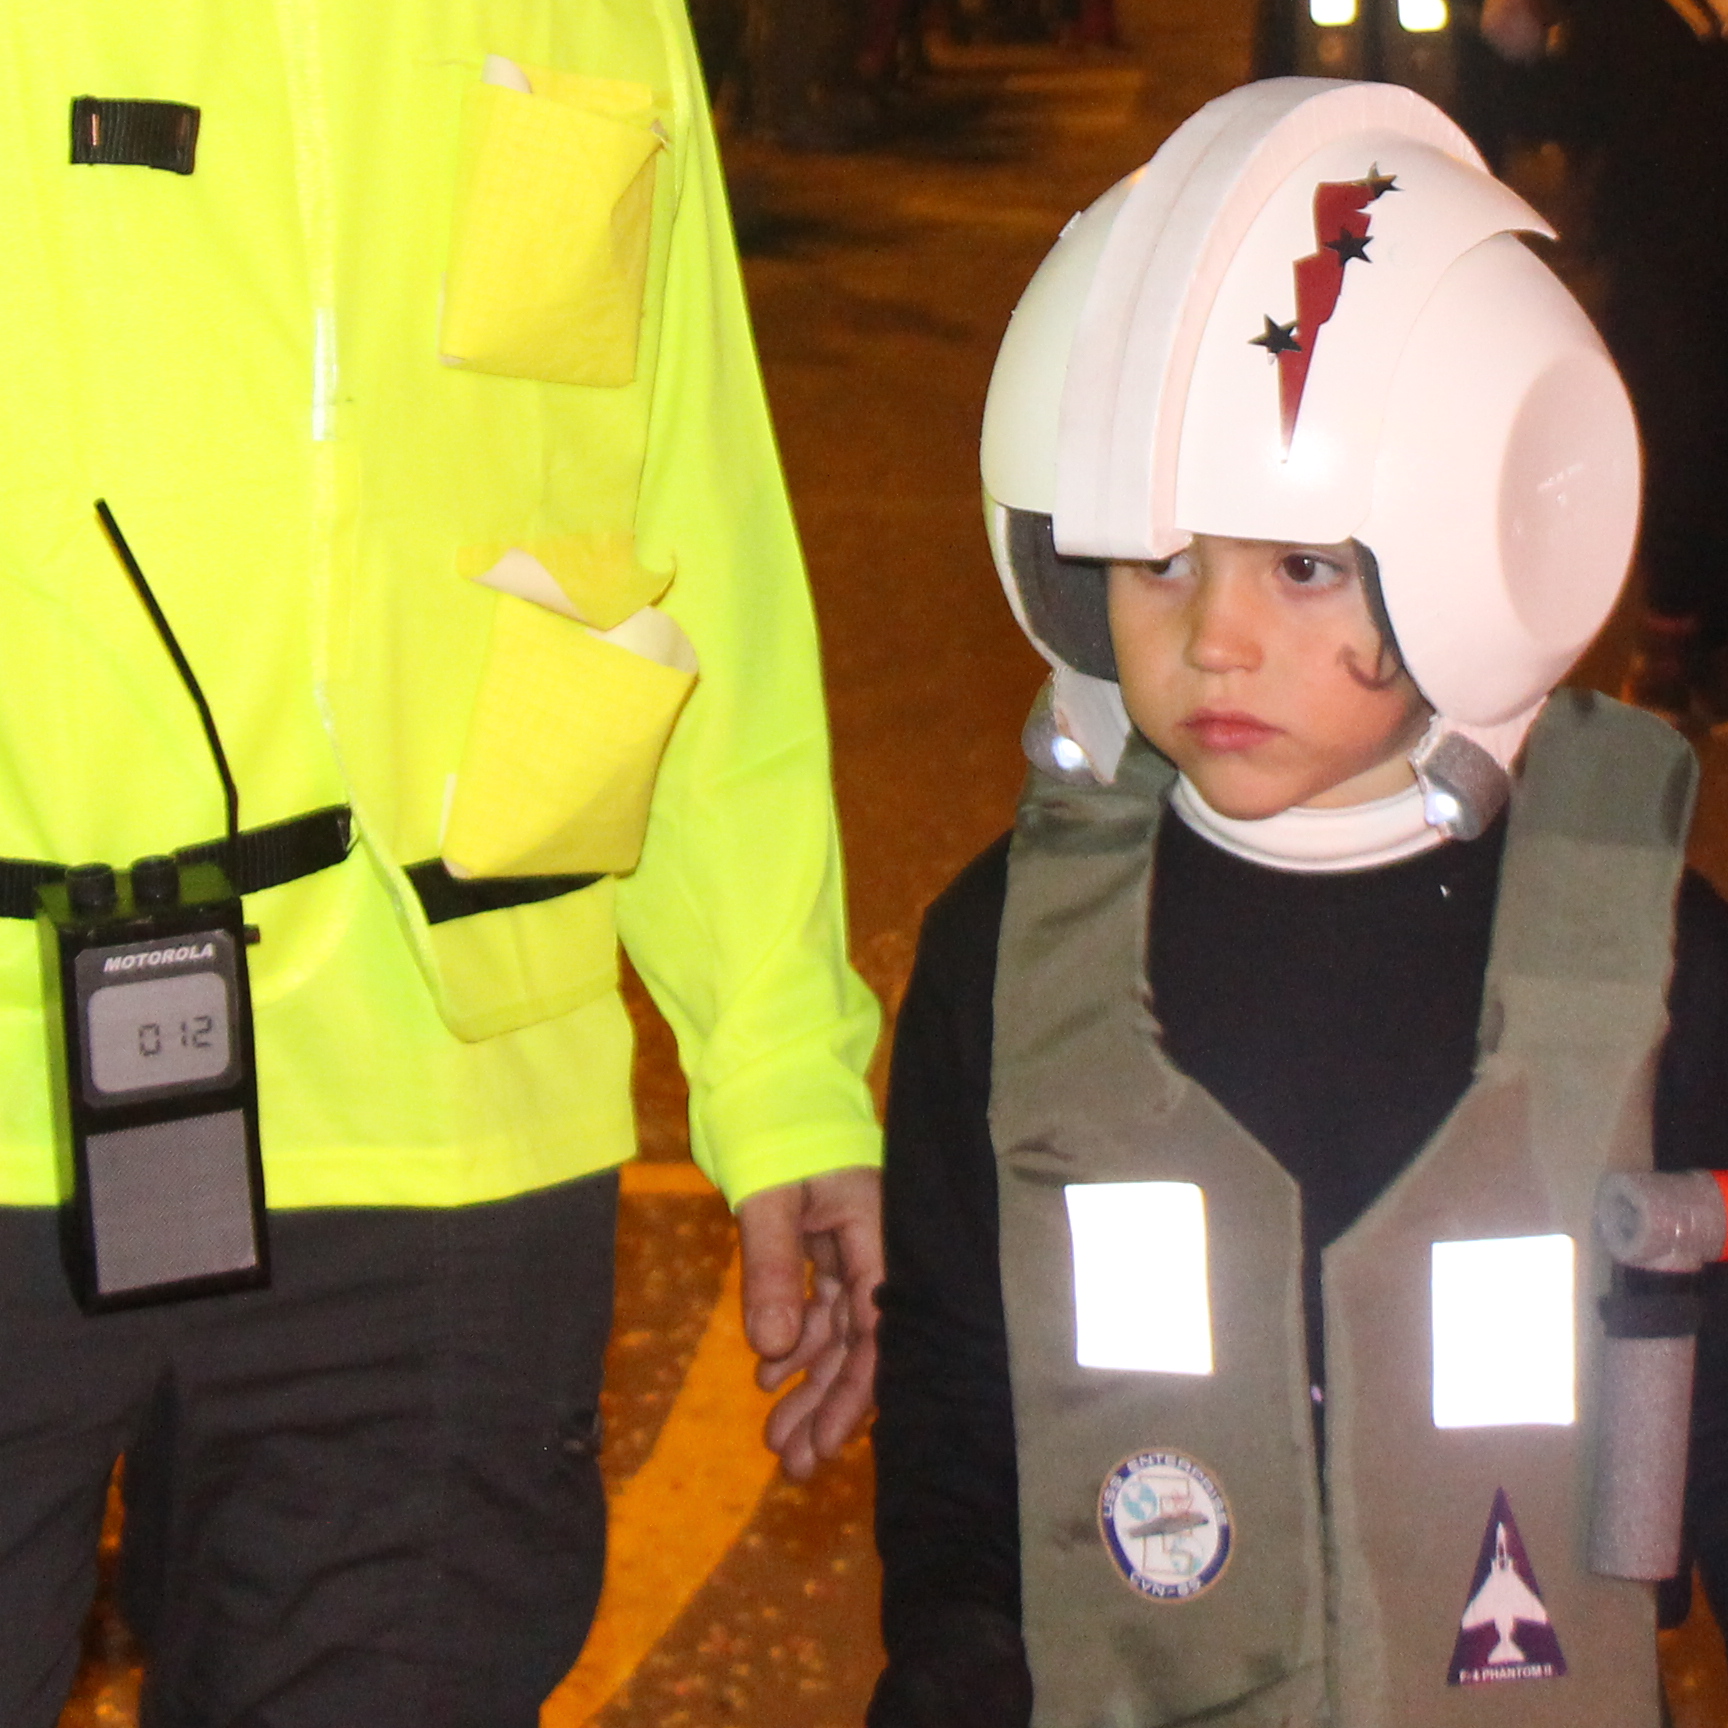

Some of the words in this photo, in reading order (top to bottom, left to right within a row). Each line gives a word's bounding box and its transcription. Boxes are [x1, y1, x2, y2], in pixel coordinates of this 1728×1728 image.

[103, 942, 215, 973] MOTOROLA
[1103, 1475, 1123, 1519] USS
[1482, 1663, 1542, 1681] PHANTOM
